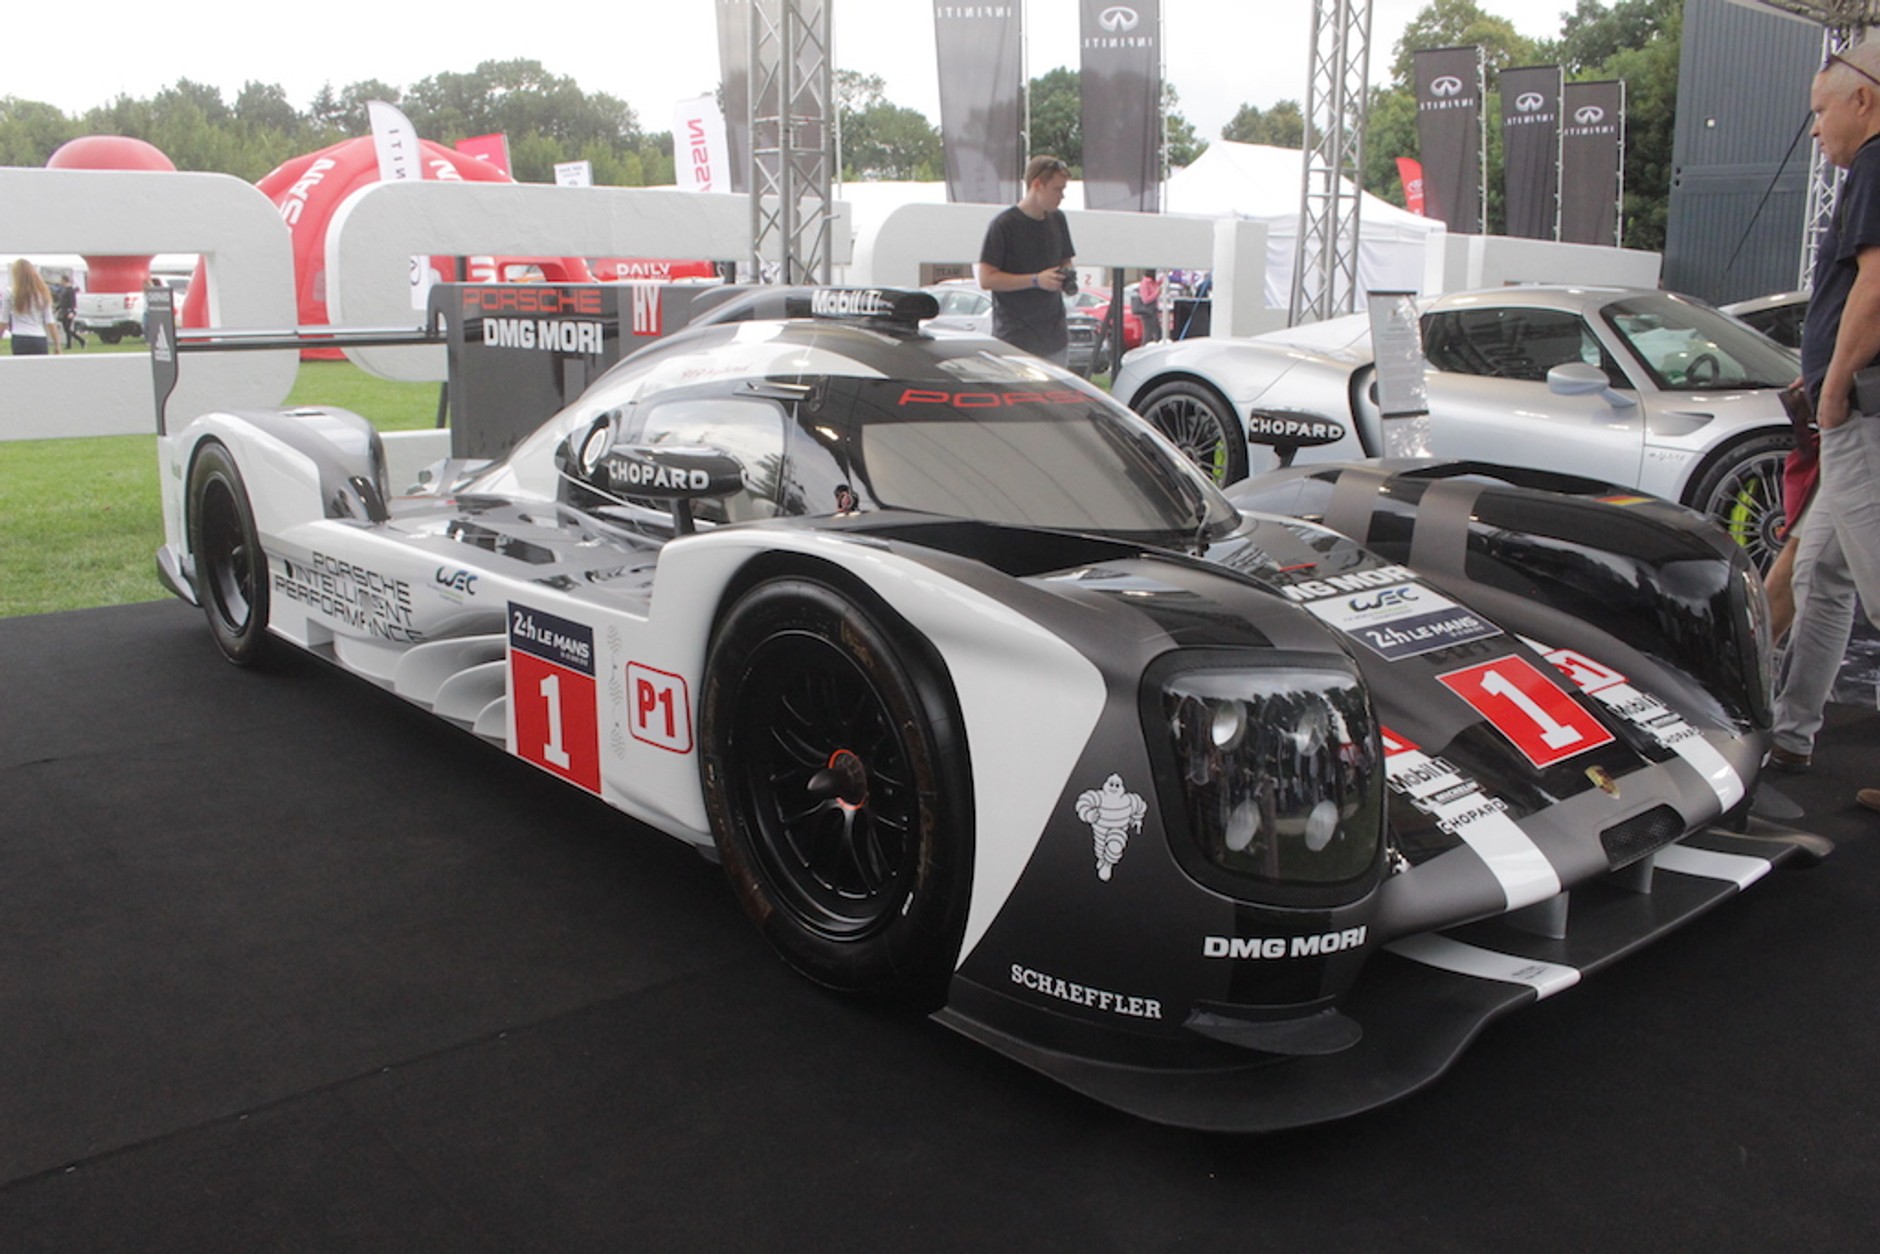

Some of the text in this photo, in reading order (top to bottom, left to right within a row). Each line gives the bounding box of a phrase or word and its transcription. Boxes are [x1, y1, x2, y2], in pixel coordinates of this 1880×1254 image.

[616, 263, 670, 276] DAILY
[463, 288, 602, 313] PORSCHE
[633, 285, 660, 332] HY
[812, 289, 861, 314] Mobil
[483, 318, 603, 354] DMG MORI
[1250, 416, 1345, 440] CHOPARD
[609, 460, 709, 490] CHOPARD
[313, 551, 411, 605] PORSCHE
[537, 628, 552, 646] LE
[553, 633, 590, 659] MANS
[1406, 626, 1434, 640] LE
[1428, 616, 1479, 635] MANS
[540, 674, 570, 769] 1
[637, 678, 675, 738] P1
[1480, 669, 1583, 750] 1
[1440, 800, 1507, 832] CHOPARD
[1204, 926, 1367, 958] DMG MORI
[1010, 964, 1162, 1019] SCHAEFFLER
